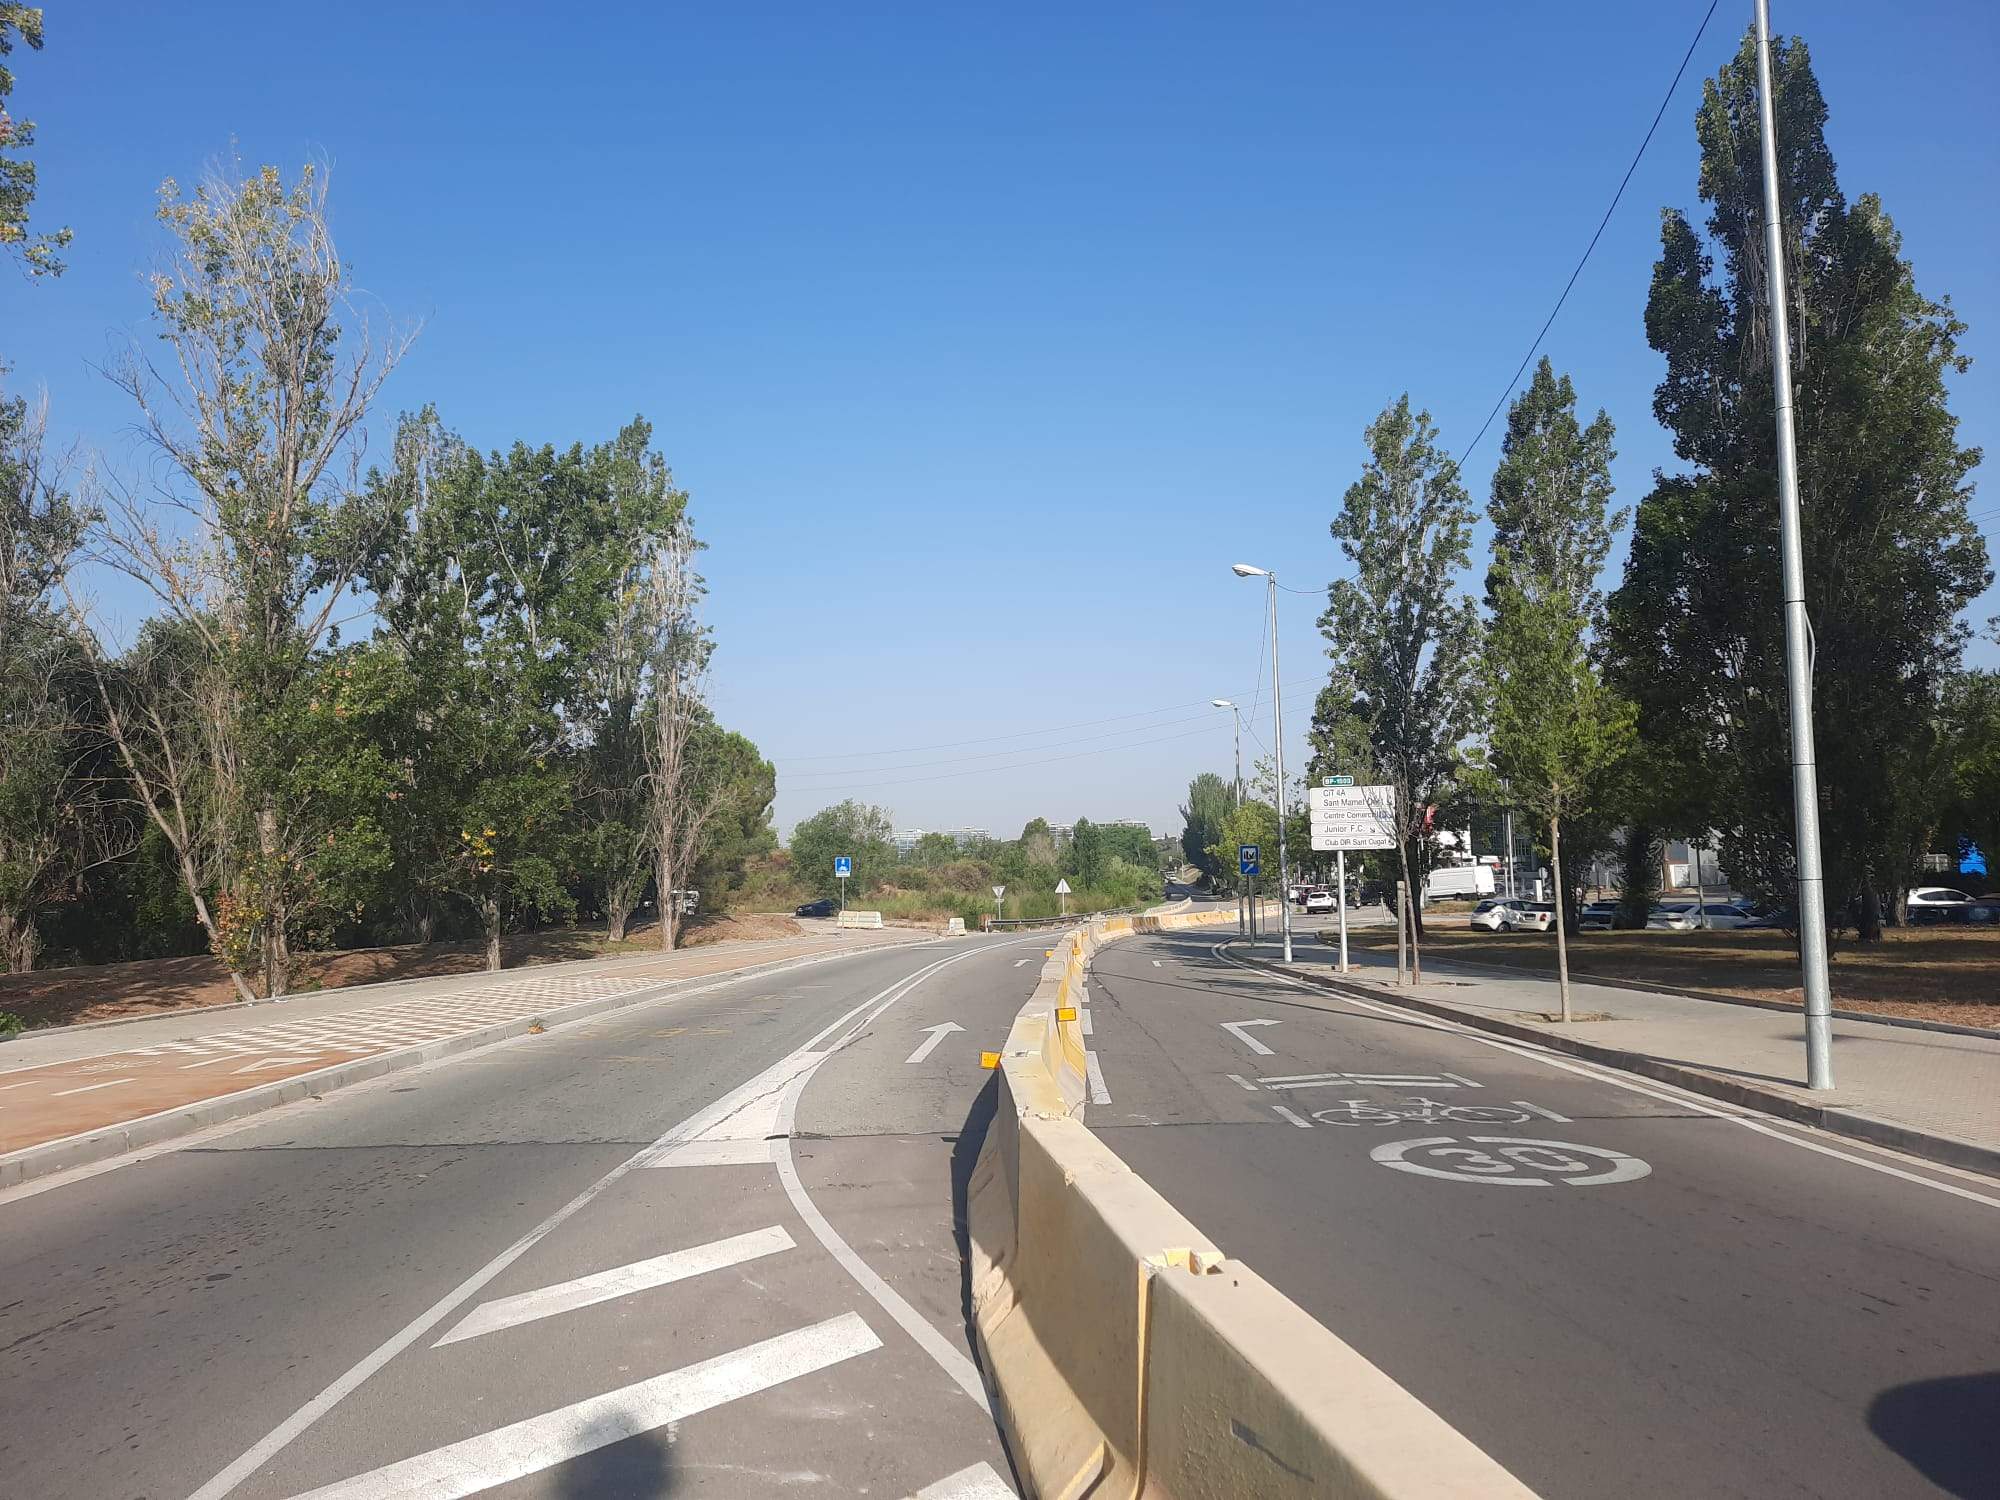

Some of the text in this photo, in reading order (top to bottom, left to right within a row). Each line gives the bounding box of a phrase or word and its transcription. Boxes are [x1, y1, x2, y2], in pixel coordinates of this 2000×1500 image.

[1324, 799, 1339, 807] Sant
[1324, 825, 1365, 833] Junior F.C.
[1353, 838, 1367, 846] Sant
[1369, 838, 1387, 847] Cugat
[1428, 1147, 1590, 1174] 30
